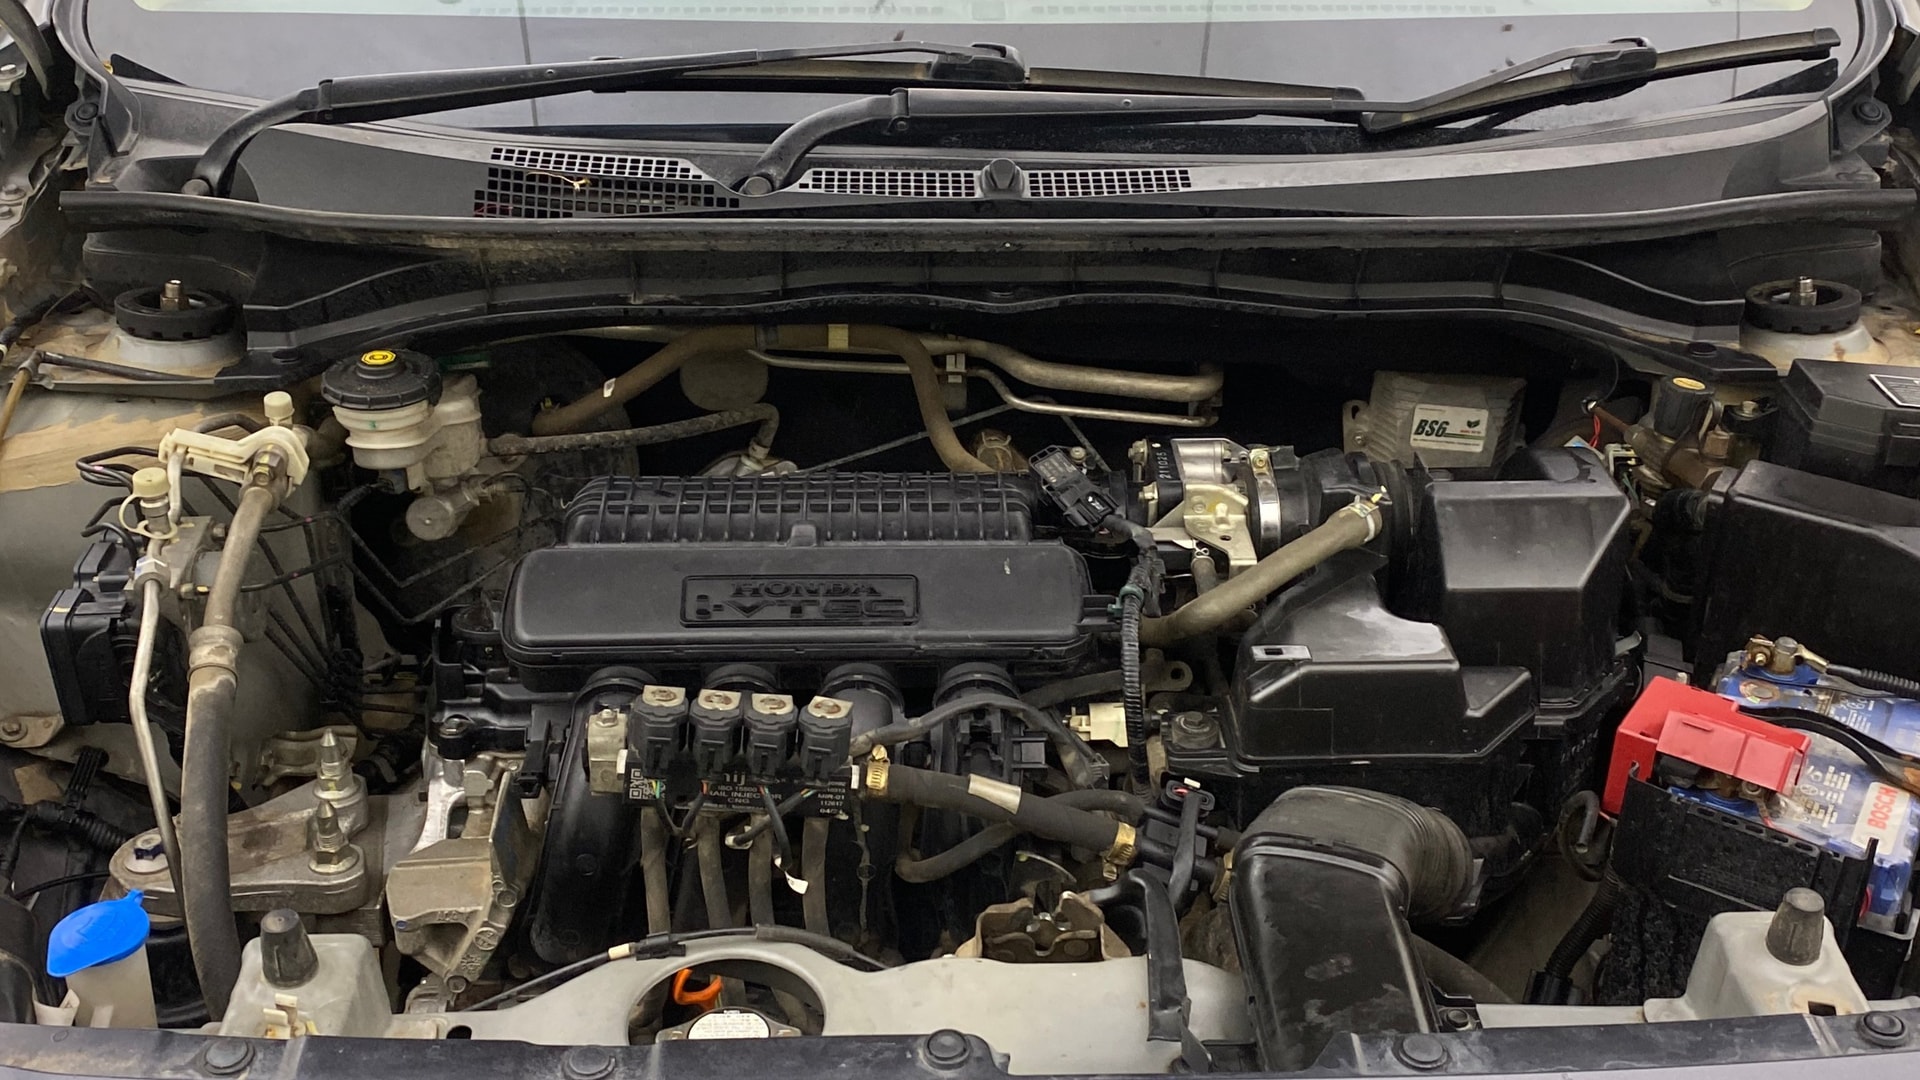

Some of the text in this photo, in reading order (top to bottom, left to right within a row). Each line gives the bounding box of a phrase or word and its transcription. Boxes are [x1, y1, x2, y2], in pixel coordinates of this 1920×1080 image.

[730, 582, 882, 598] HONDA
[694, 593, 906, 620] i-VTEC
[1866, 785, 1899, 831] BOSCH
